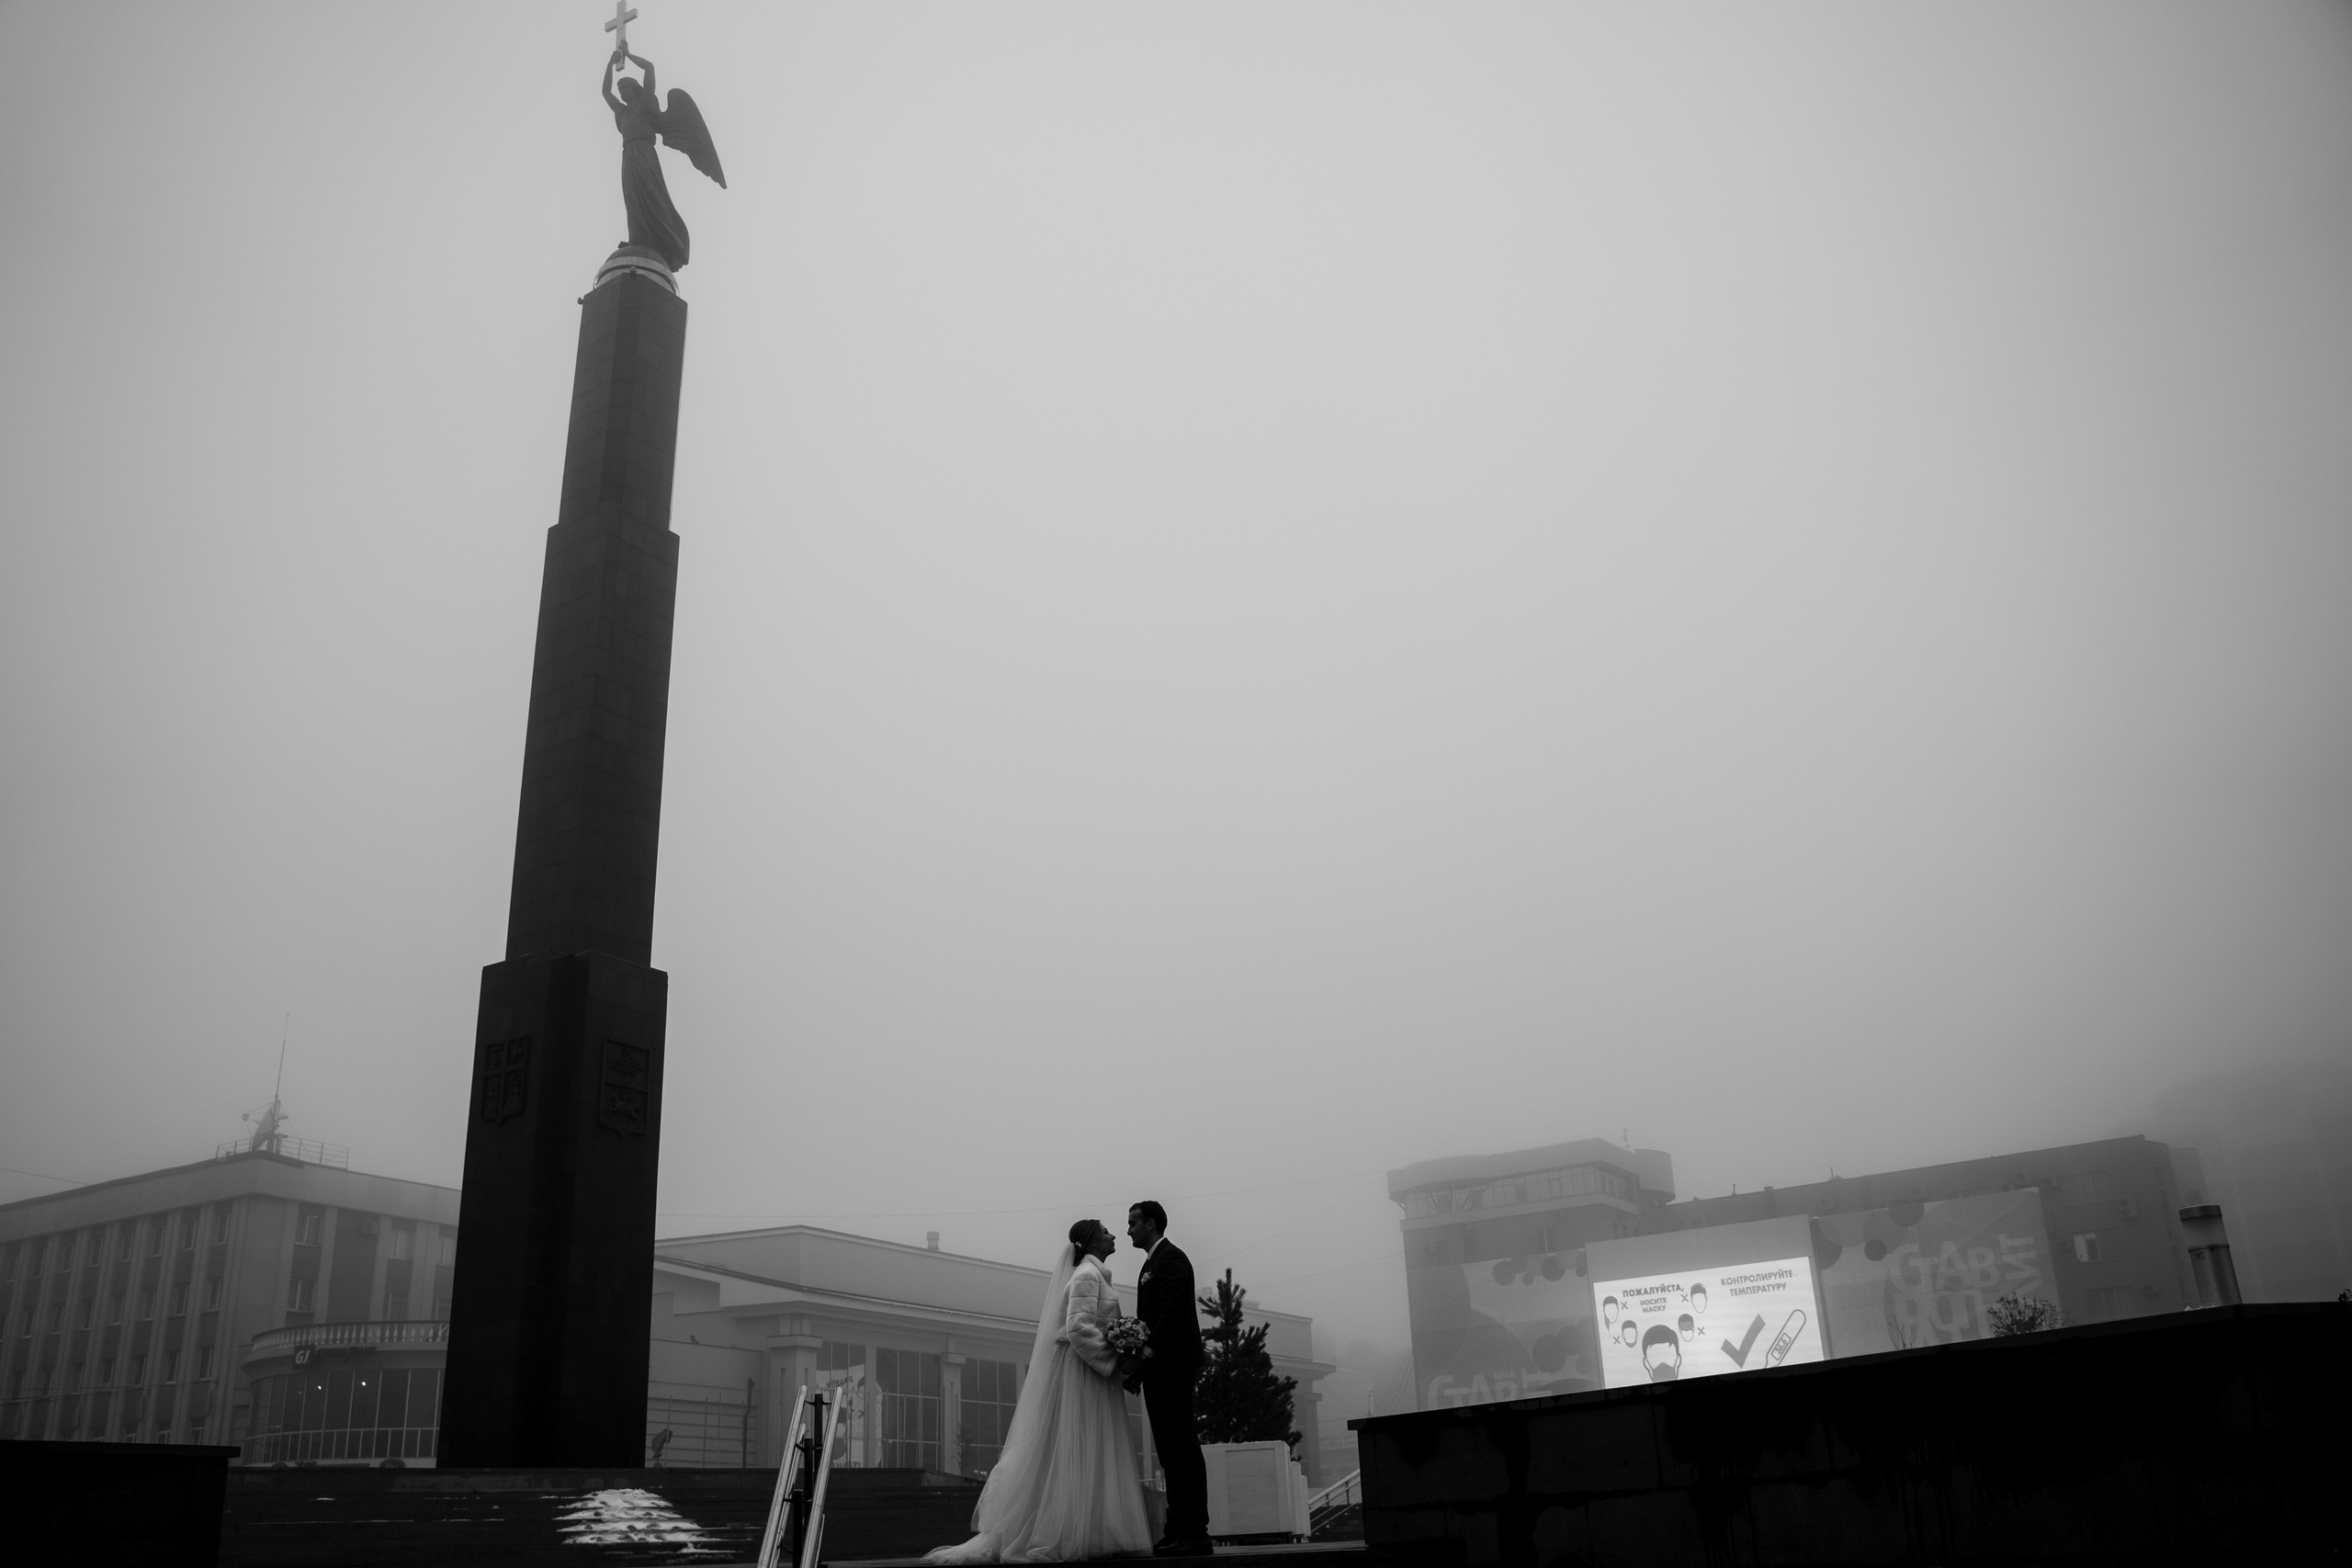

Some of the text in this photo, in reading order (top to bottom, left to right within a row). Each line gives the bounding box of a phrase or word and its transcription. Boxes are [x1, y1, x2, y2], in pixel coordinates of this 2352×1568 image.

[1720, 1269, 1793, 1286] КОНТРОЛИРУЙТЕ
[1623, 1283, 1684, 1298] ПОЖАЛУЙСТА,
[1729, 1282, 1787, 1297] ТЕМПЕРАТУРУ
[1640, 1297, 1668, 1306] НОСИТЕ
[1642, 1304, 1667, 1314] МАСКУ
